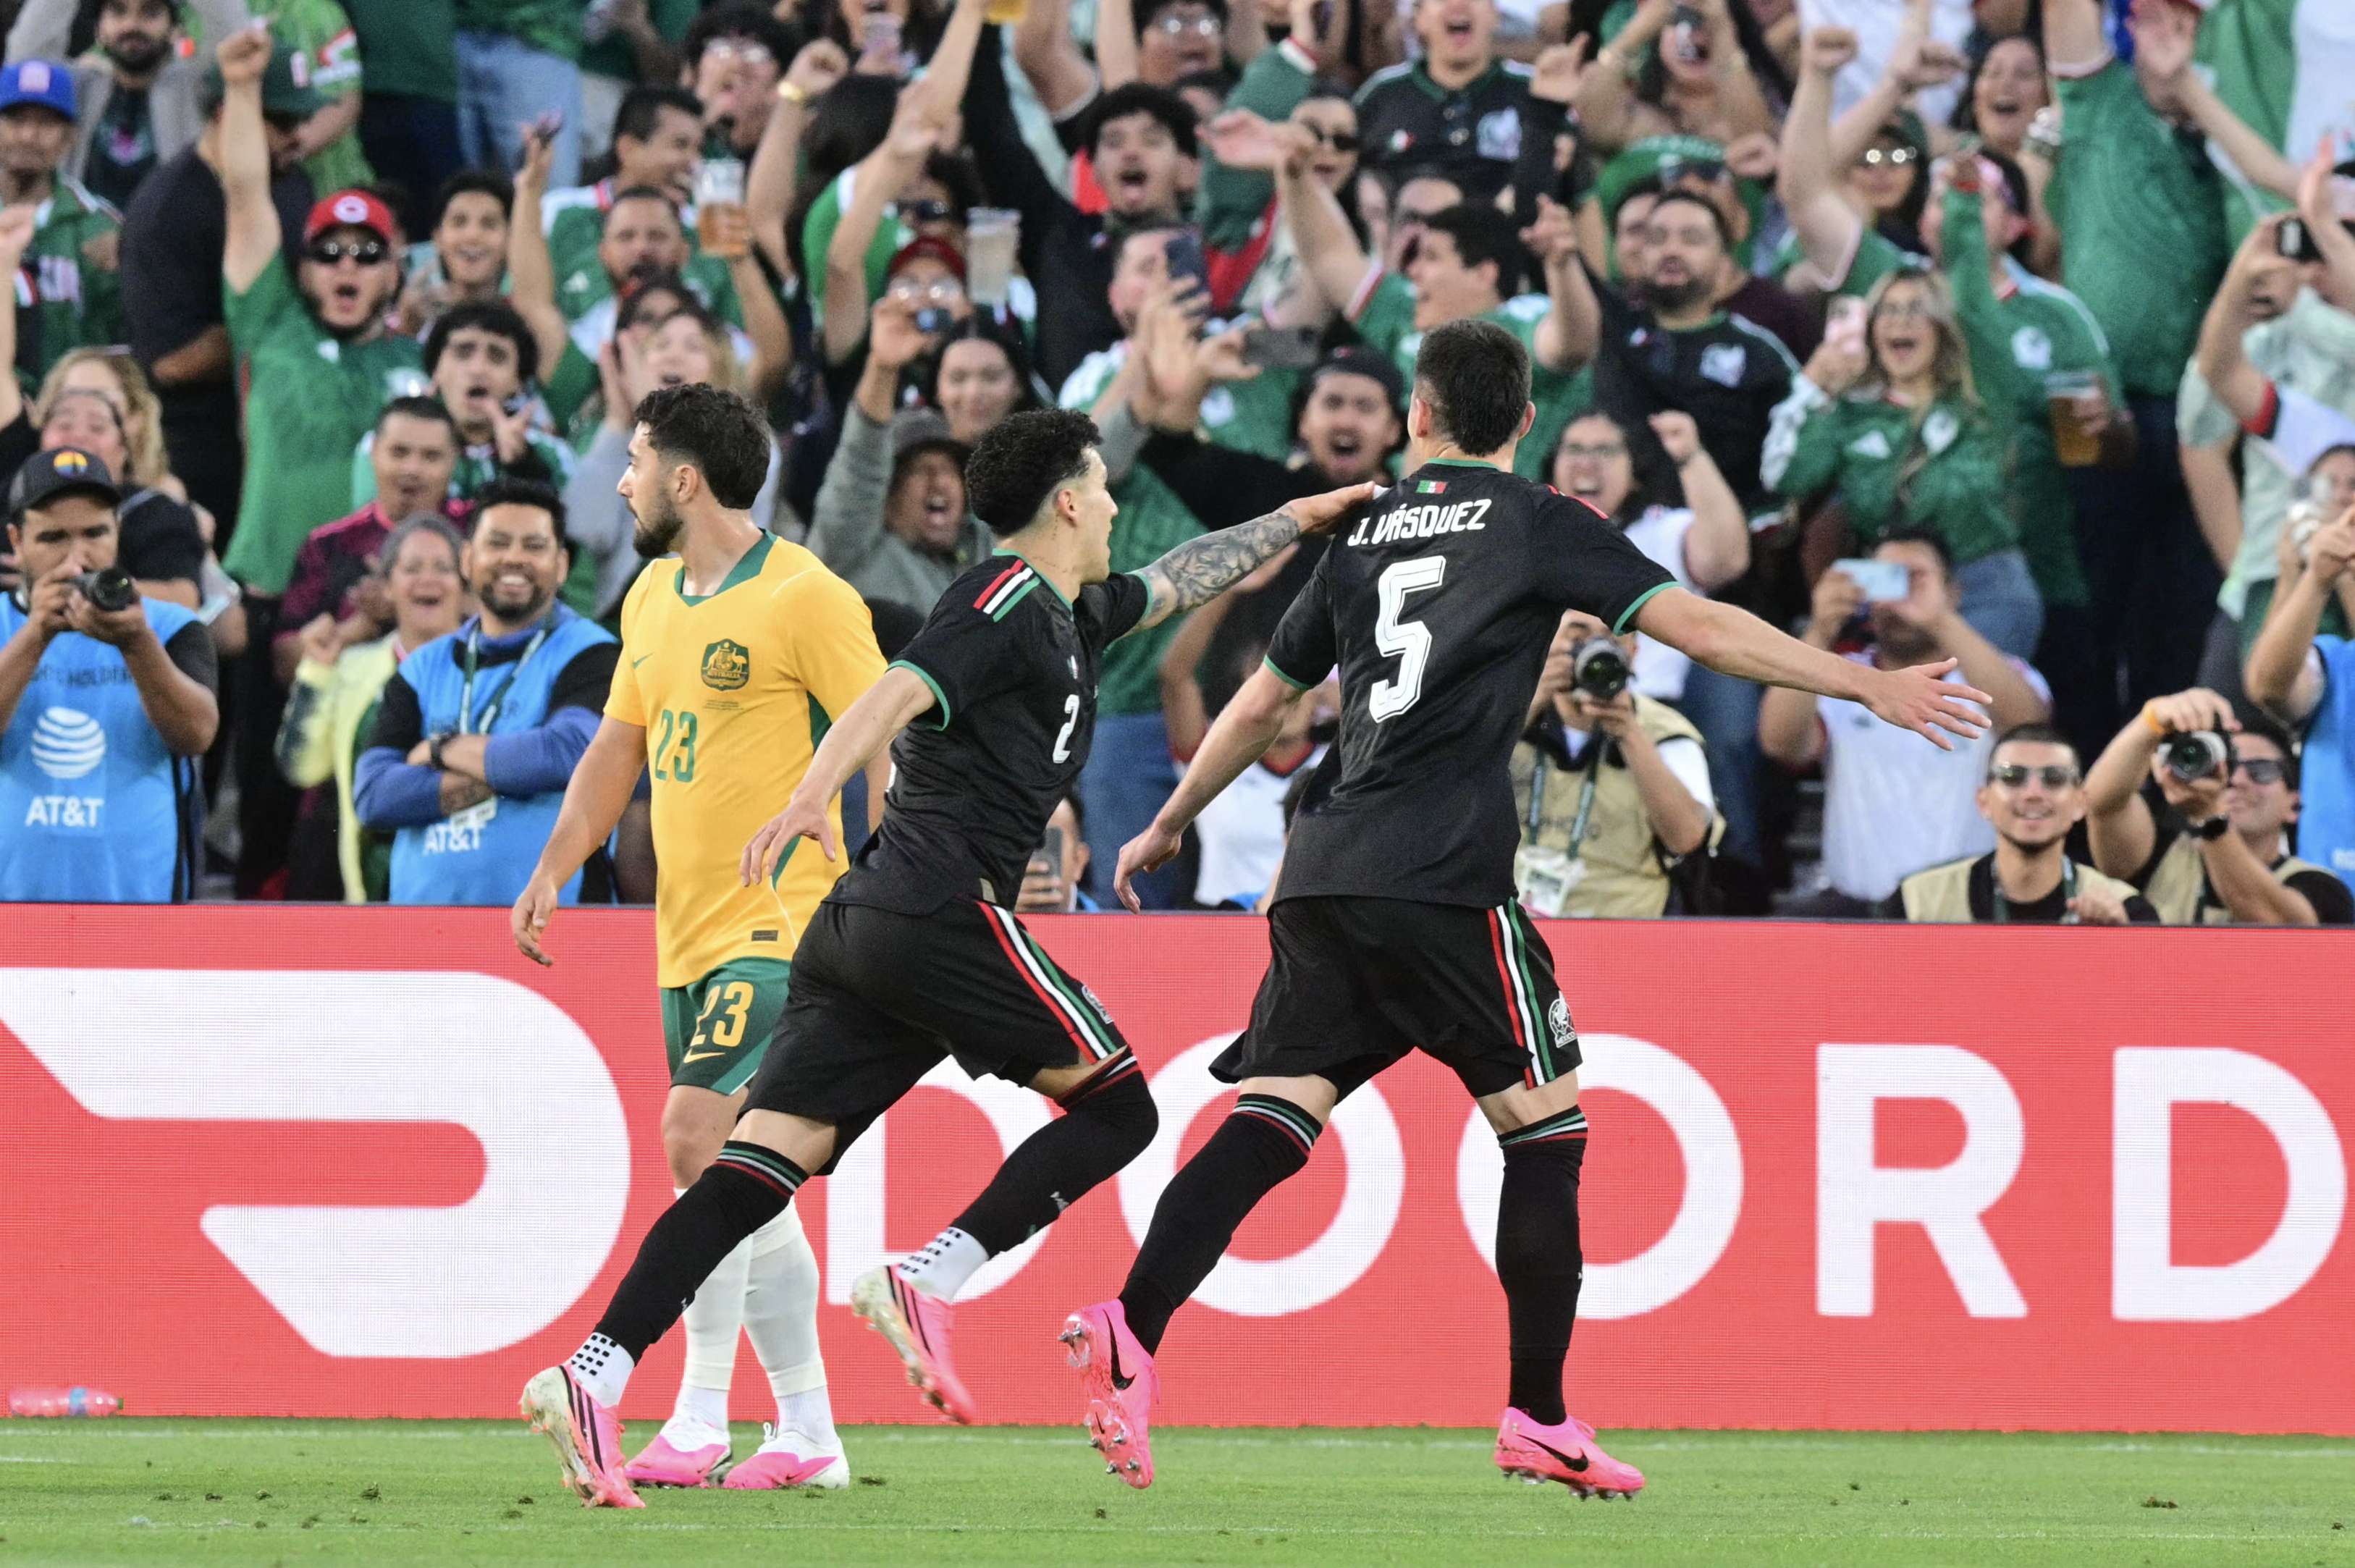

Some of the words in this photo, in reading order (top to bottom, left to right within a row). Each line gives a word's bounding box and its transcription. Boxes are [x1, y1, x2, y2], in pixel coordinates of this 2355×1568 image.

[1347, 517, 1370, 547] J.
[1371, 499, 1492, 545] VÁSQUEZ
[1369, 555, 1446, 723] 5
[655, 709, 697, 783] 23
[1052, 694, 1080, 764] 2
[25, 795, 106, 827] AT&T
[423, 822, 487, 856] AT&T
[690, 981, 754, 1048] 23
[827, 1031, 2348, 1323] DOORD
